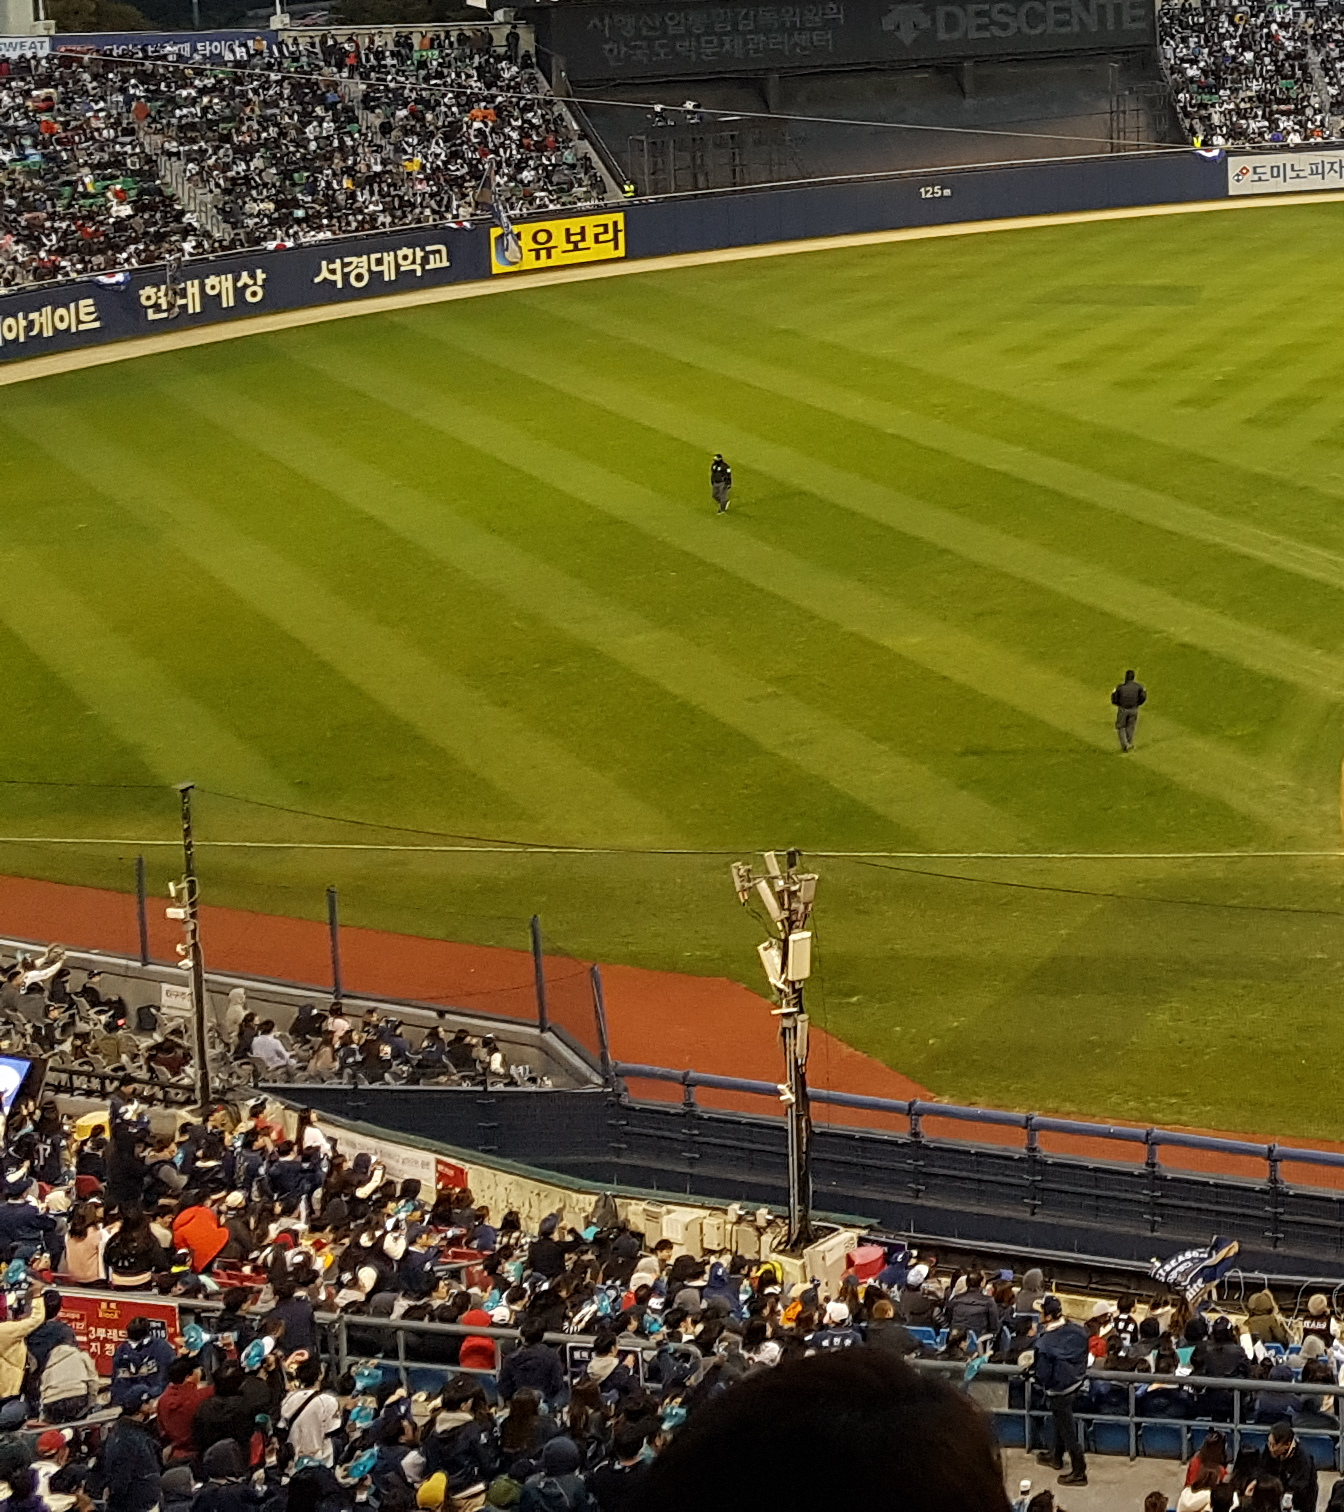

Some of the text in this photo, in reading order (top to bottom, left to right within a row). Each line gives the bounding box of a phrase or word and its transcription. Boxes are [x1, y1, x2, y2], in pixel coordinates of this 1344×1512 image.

[1250, 159, 1344, 185] 도미노피자
[313, 244, 450, 288] 서경대학교
[139, 269, 266, 320] 현대해상
[0, 298, 101, 344] 아게이트
